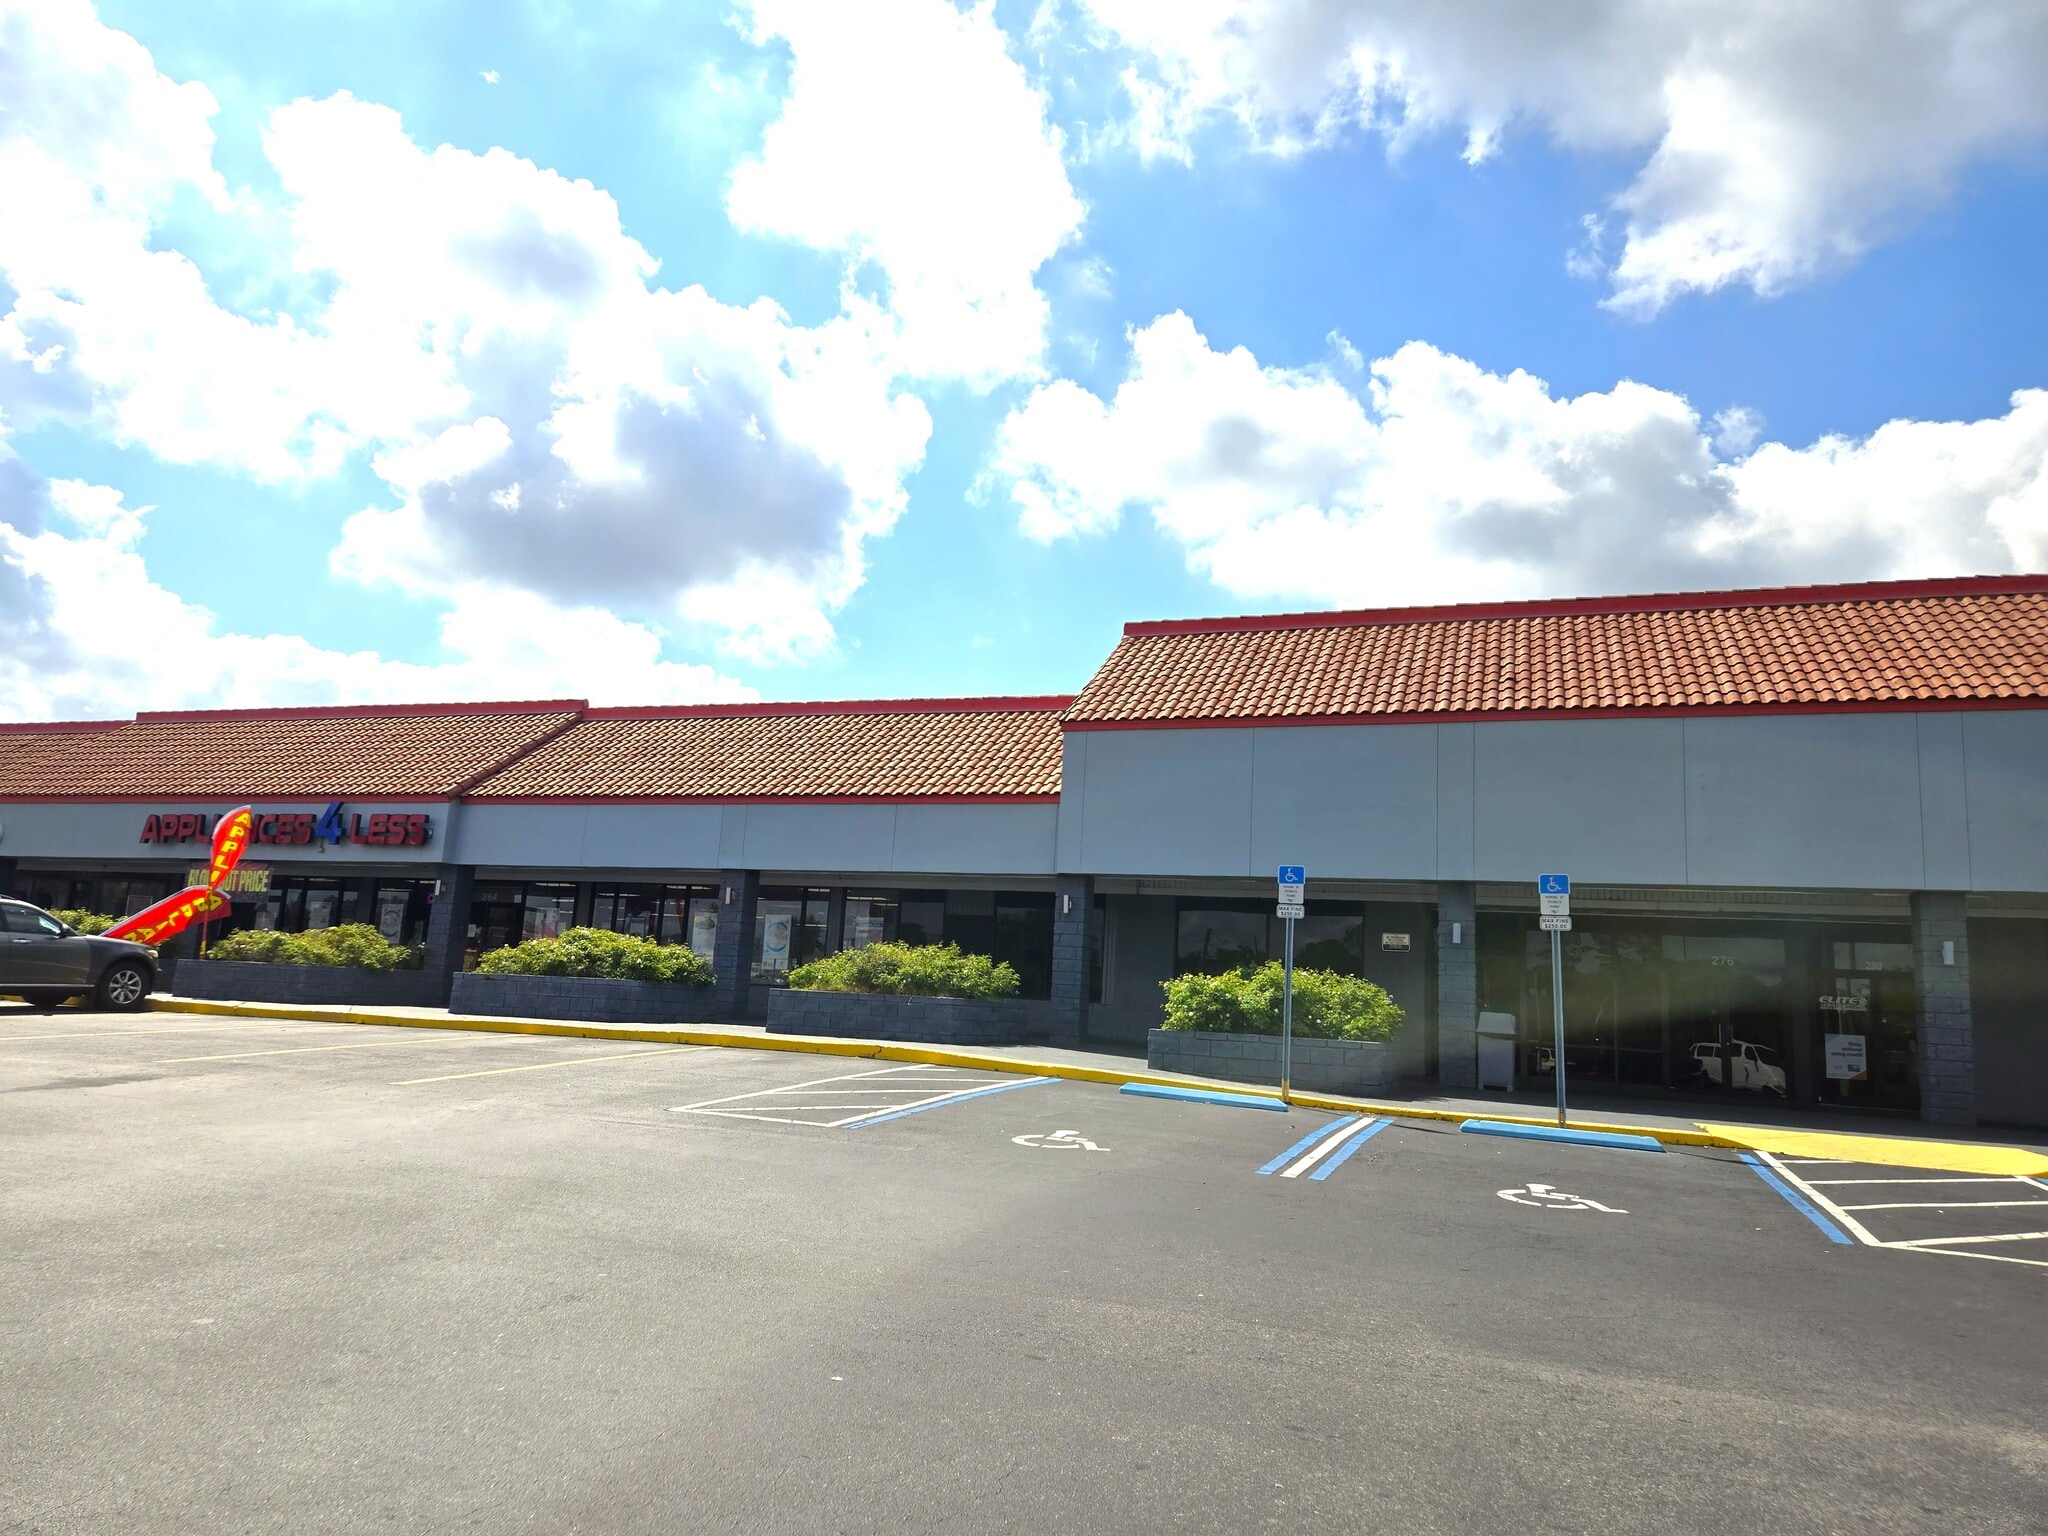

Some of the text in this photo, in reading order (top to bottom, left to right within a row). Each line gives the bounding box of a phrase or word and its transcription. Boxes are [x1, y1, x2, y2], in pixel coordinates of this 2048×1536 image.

[315, 800, 344, 845] 4
[350, 813, 430, 845] LESS
[239, 869, 269, 892] PRICE
[482, 892, 497, 901] 264
[1711, 955, 1734, 966] 276
